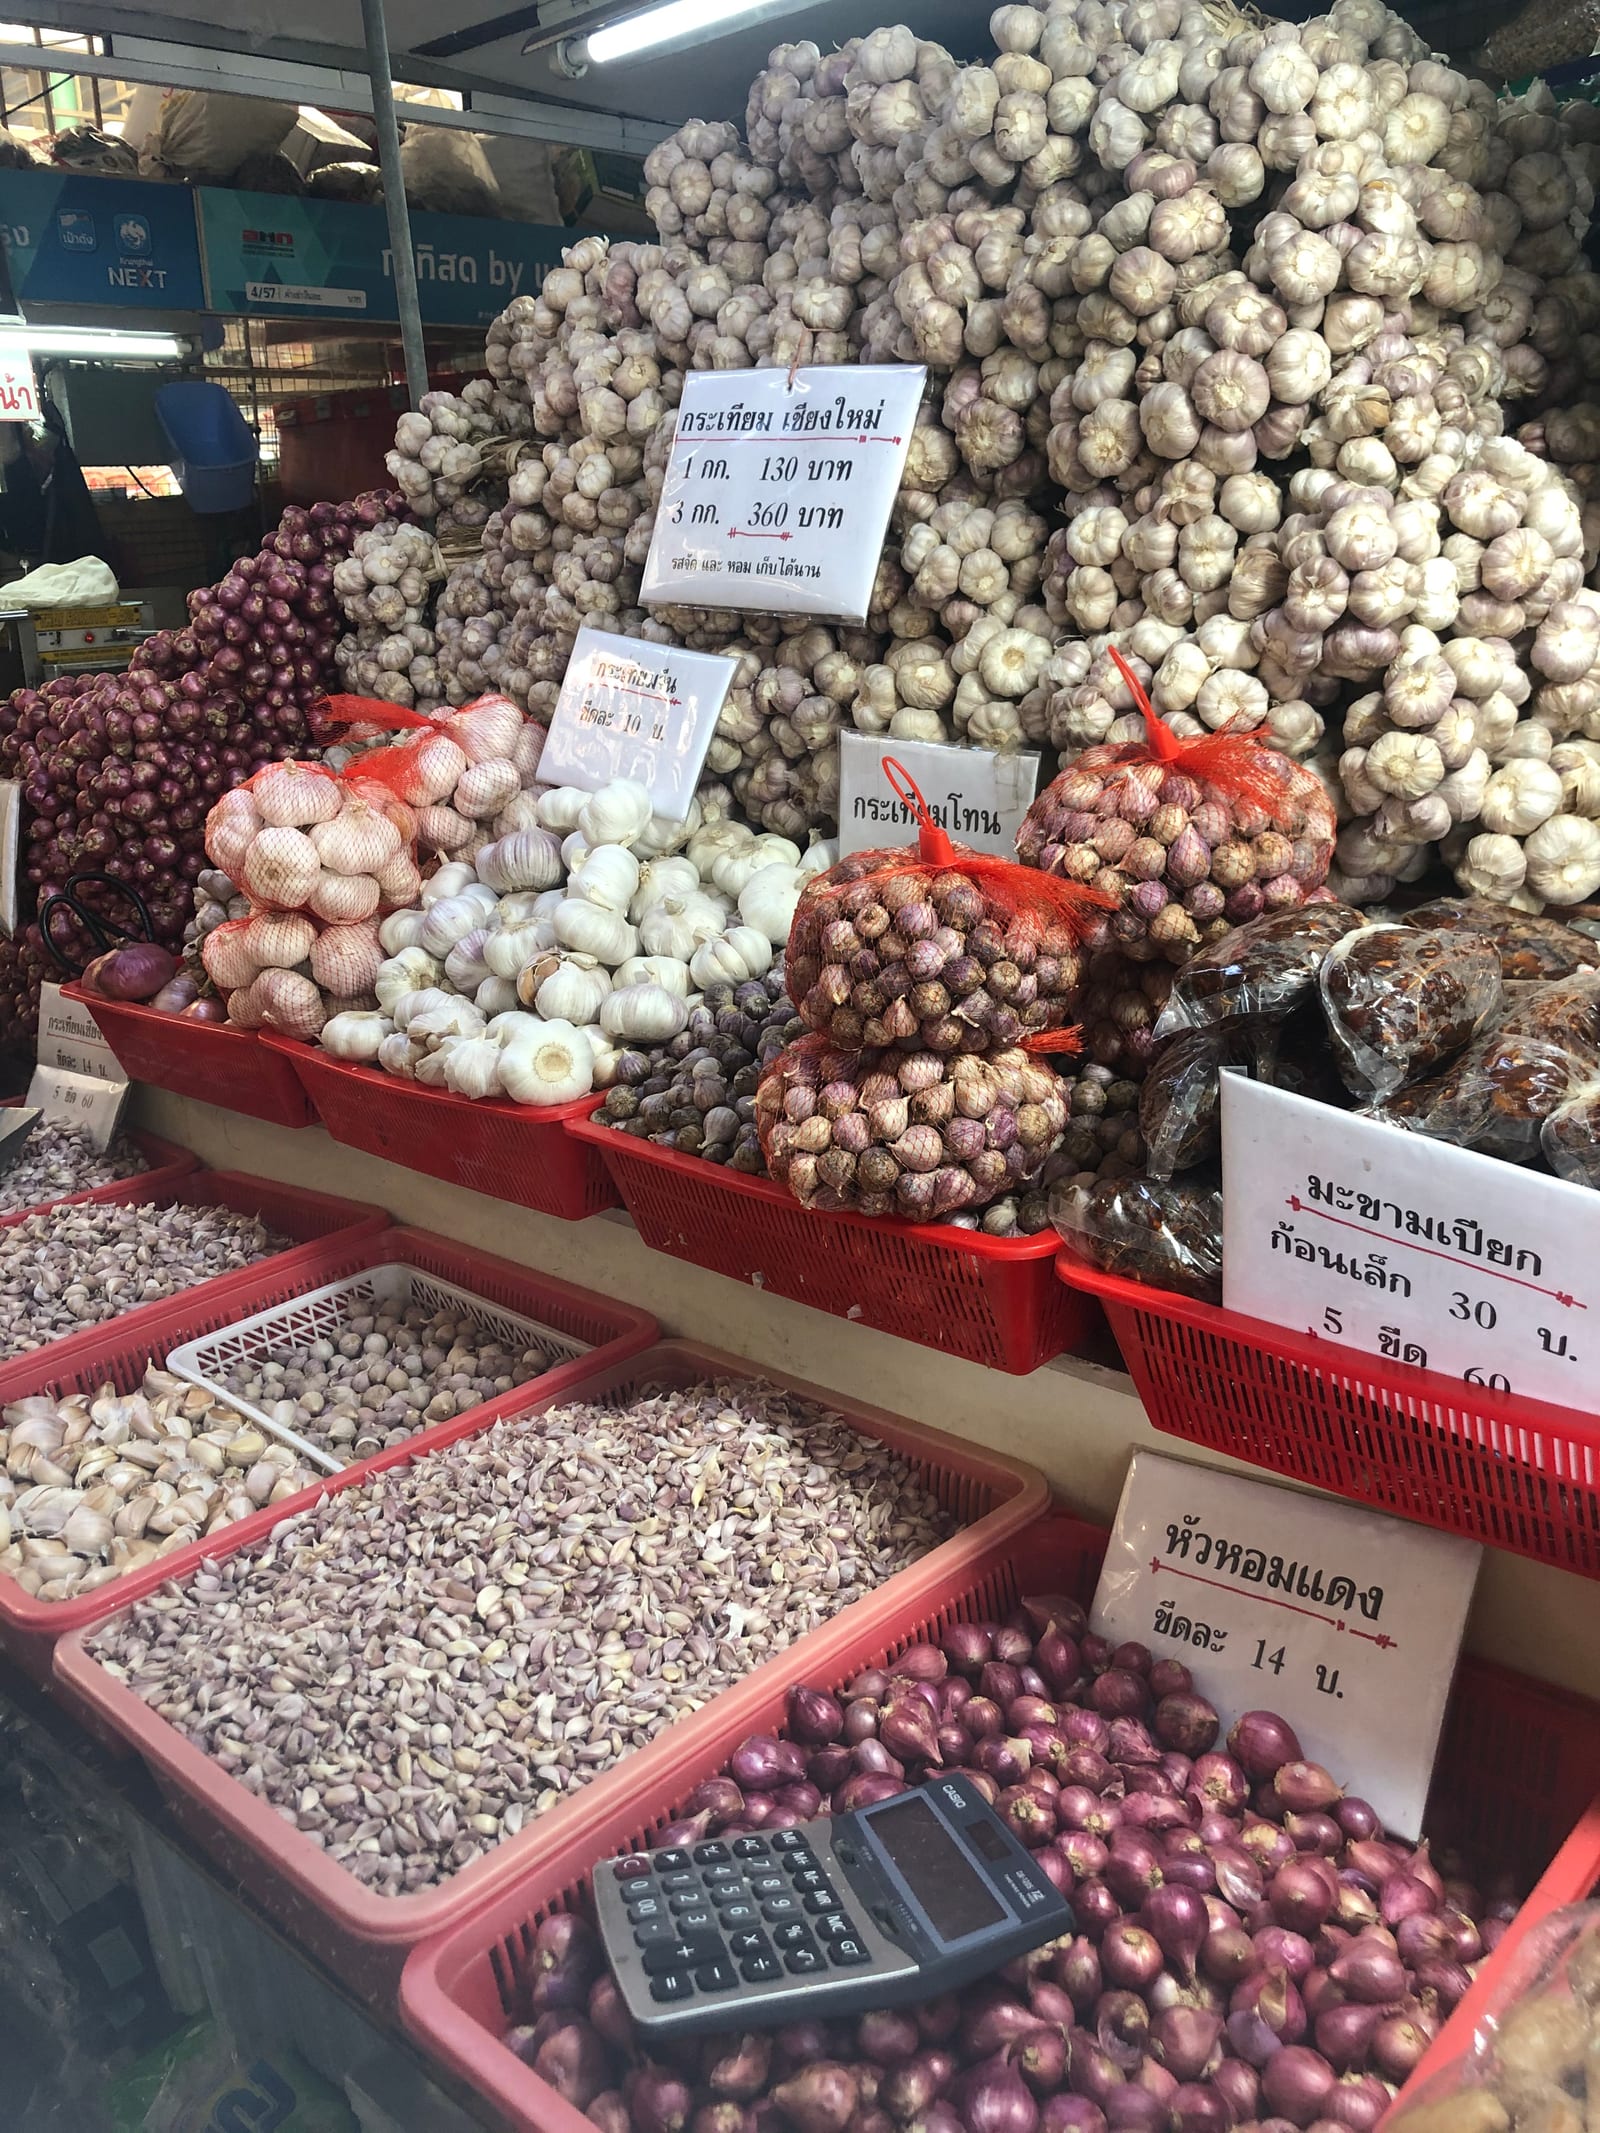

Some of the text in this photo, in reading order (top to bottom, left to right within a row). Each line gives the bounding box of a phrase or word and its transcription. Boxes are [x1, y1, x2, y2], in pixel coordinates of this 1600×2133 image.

[108, 267, 168, 289] NEXT
[488, 249, 523, 295] by
[250, 286, 276, 299] 4/57
[681, 397, 885, 432] กระเทียม เชียงใหม่
[682, 456, 853, 482] 1 กก. 130 บาท
[671, 500, 844, 529] 3 กก. 360 บาท
[727, 559, 751, 574] หอม
[623, 713, 641, 734] 10
[853, 791, 1001, 835] กระเทียมโทน
[81, 1095, 94, 1109] 60
[1306, 1174, 1543, 1277] มะขามเปียก
[1270, 1221, 1578, 1363] ก้อนเล็ก 30 บ.
[1323, 1306, 1343, 1335] 5
[1378, 1325, 1428, 1368] ขีด
[1165, 1514, 1384, 1621] หัวหอมแดง
[1152, 1600, 1344, 1699] ขีดละ 14 บ.
[942, 1784, 967, 1809] CASIO
[624, 1860, 641, 1869] C
[713, 1866, 731, 1874] 4
[742, 1839, 760, 1850] AC
[763, 1879, 781, 1887] 8
[772, 1899, 790, 1907] 9
[630, 1881, 648, 1889] 0
[721, 1885, 740, 1894] 5
[638, 1899, 657, 1913] 00
[679, 1893, 698, 1902] 2
[688, 1914, 707, 1923] 3
[730, 1906, 749, 1915] 6
[814, 1890, 832, 1905] MR
[827, 1915, 847, 1933] MC
[840, 1940, 859, 1955] GT
